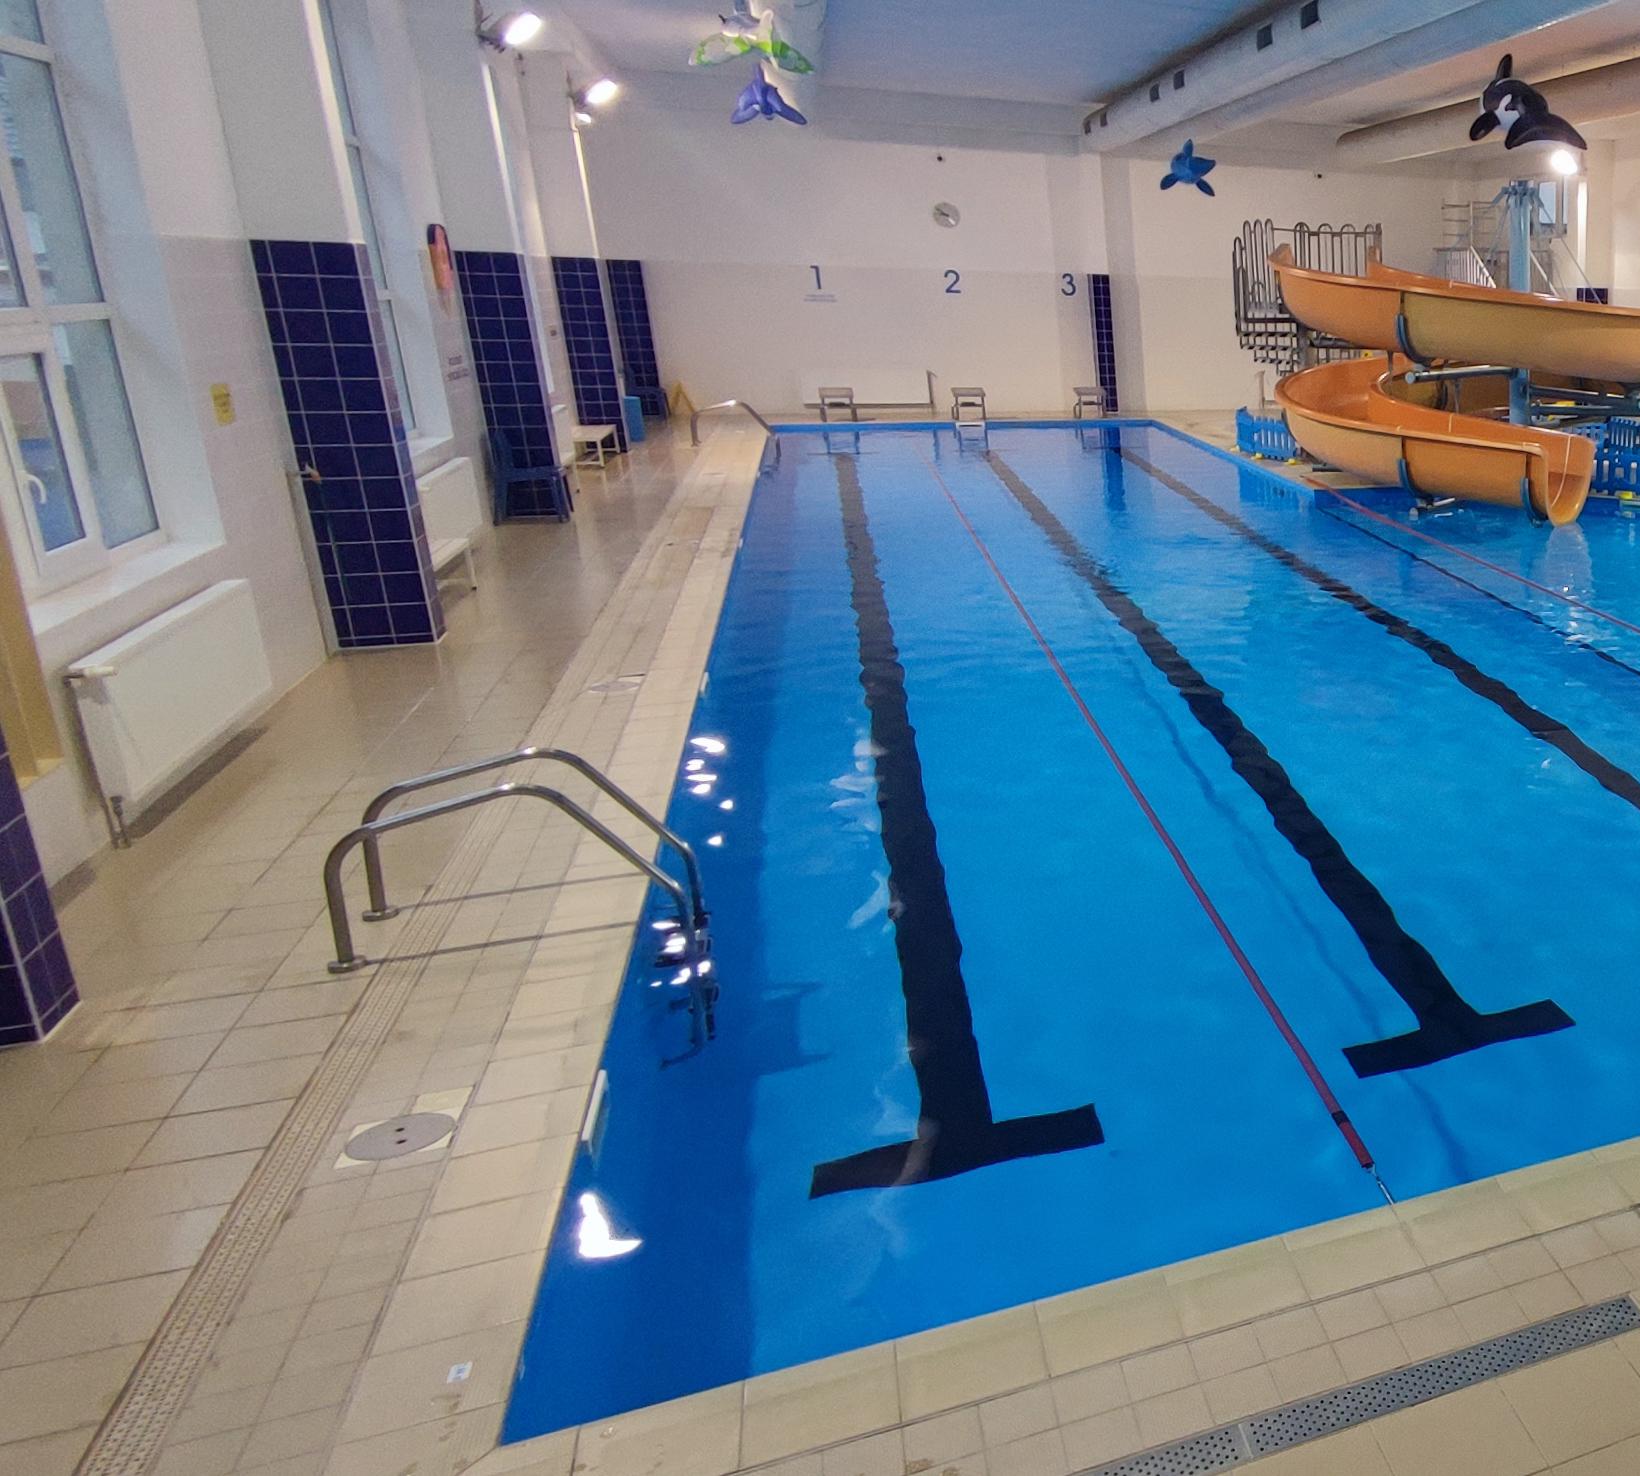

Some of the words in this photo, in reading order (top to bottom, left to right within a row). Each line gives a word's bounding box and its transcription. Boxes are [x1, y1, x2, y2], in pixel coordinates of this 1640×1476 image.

[810, 265, 822, 290] 1
[943, 269, 961, 294] 2
[1061, 273, 1076, 296] 3
